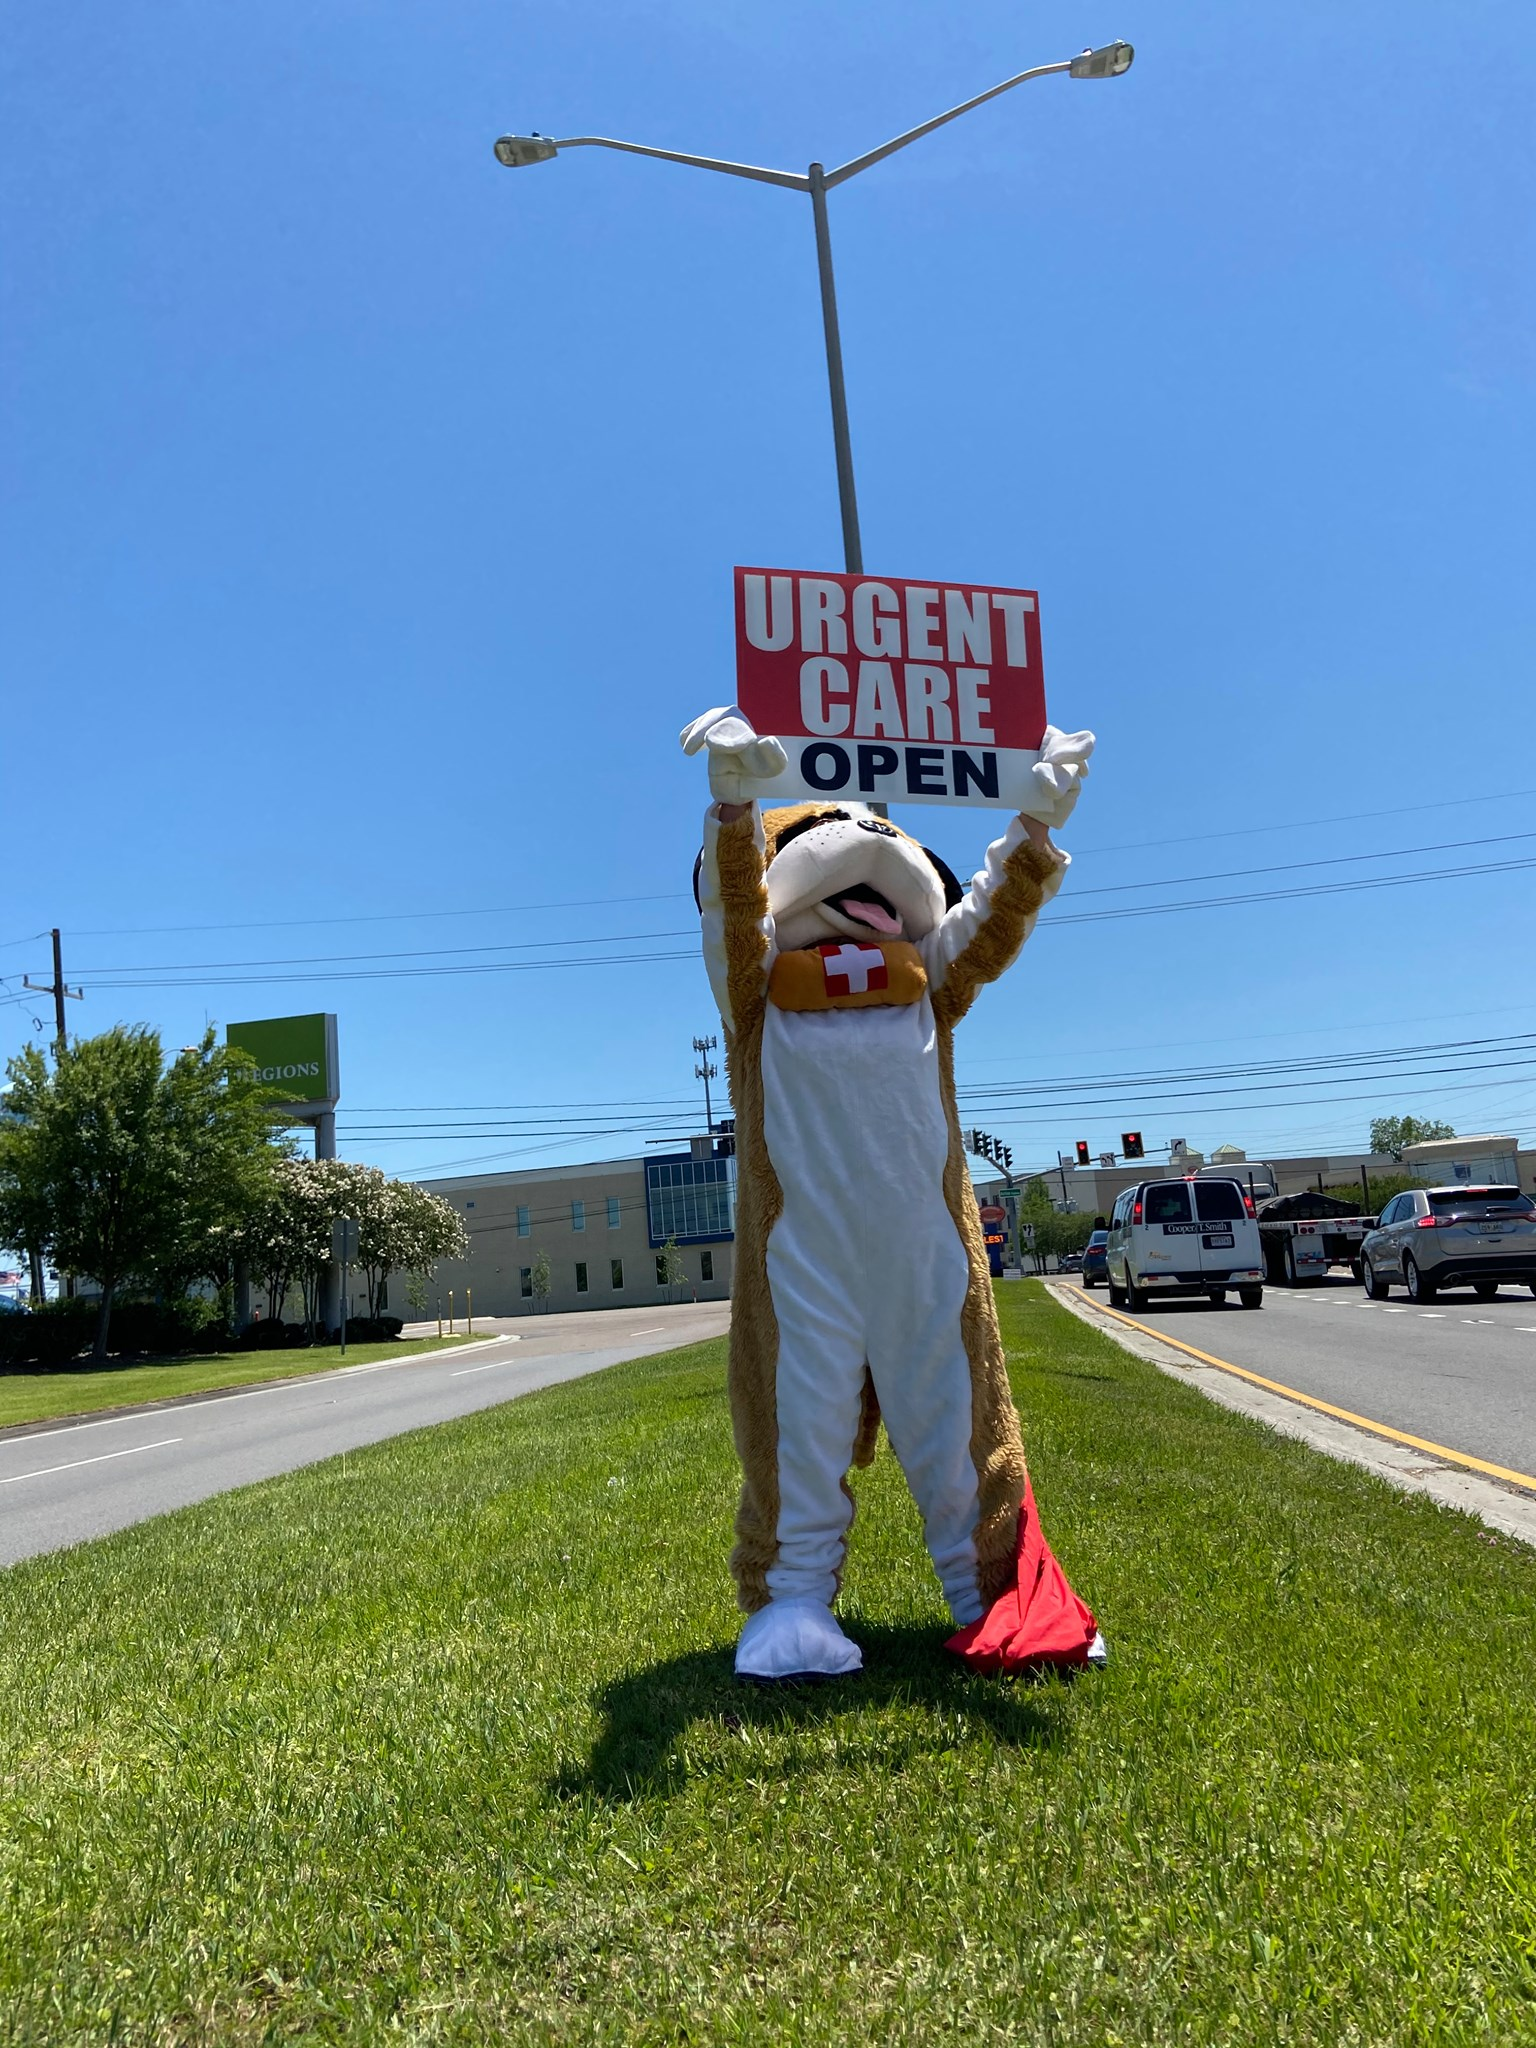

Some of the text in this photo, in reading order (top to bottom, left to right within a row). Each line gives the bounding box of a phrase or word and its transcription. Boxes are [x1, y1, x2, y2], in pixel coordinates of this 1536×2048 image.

[743, 573, 1035, 669] URGENT
[799, 656, 996, 745] CARE
[799, 741, 1000, 799] OPEN
